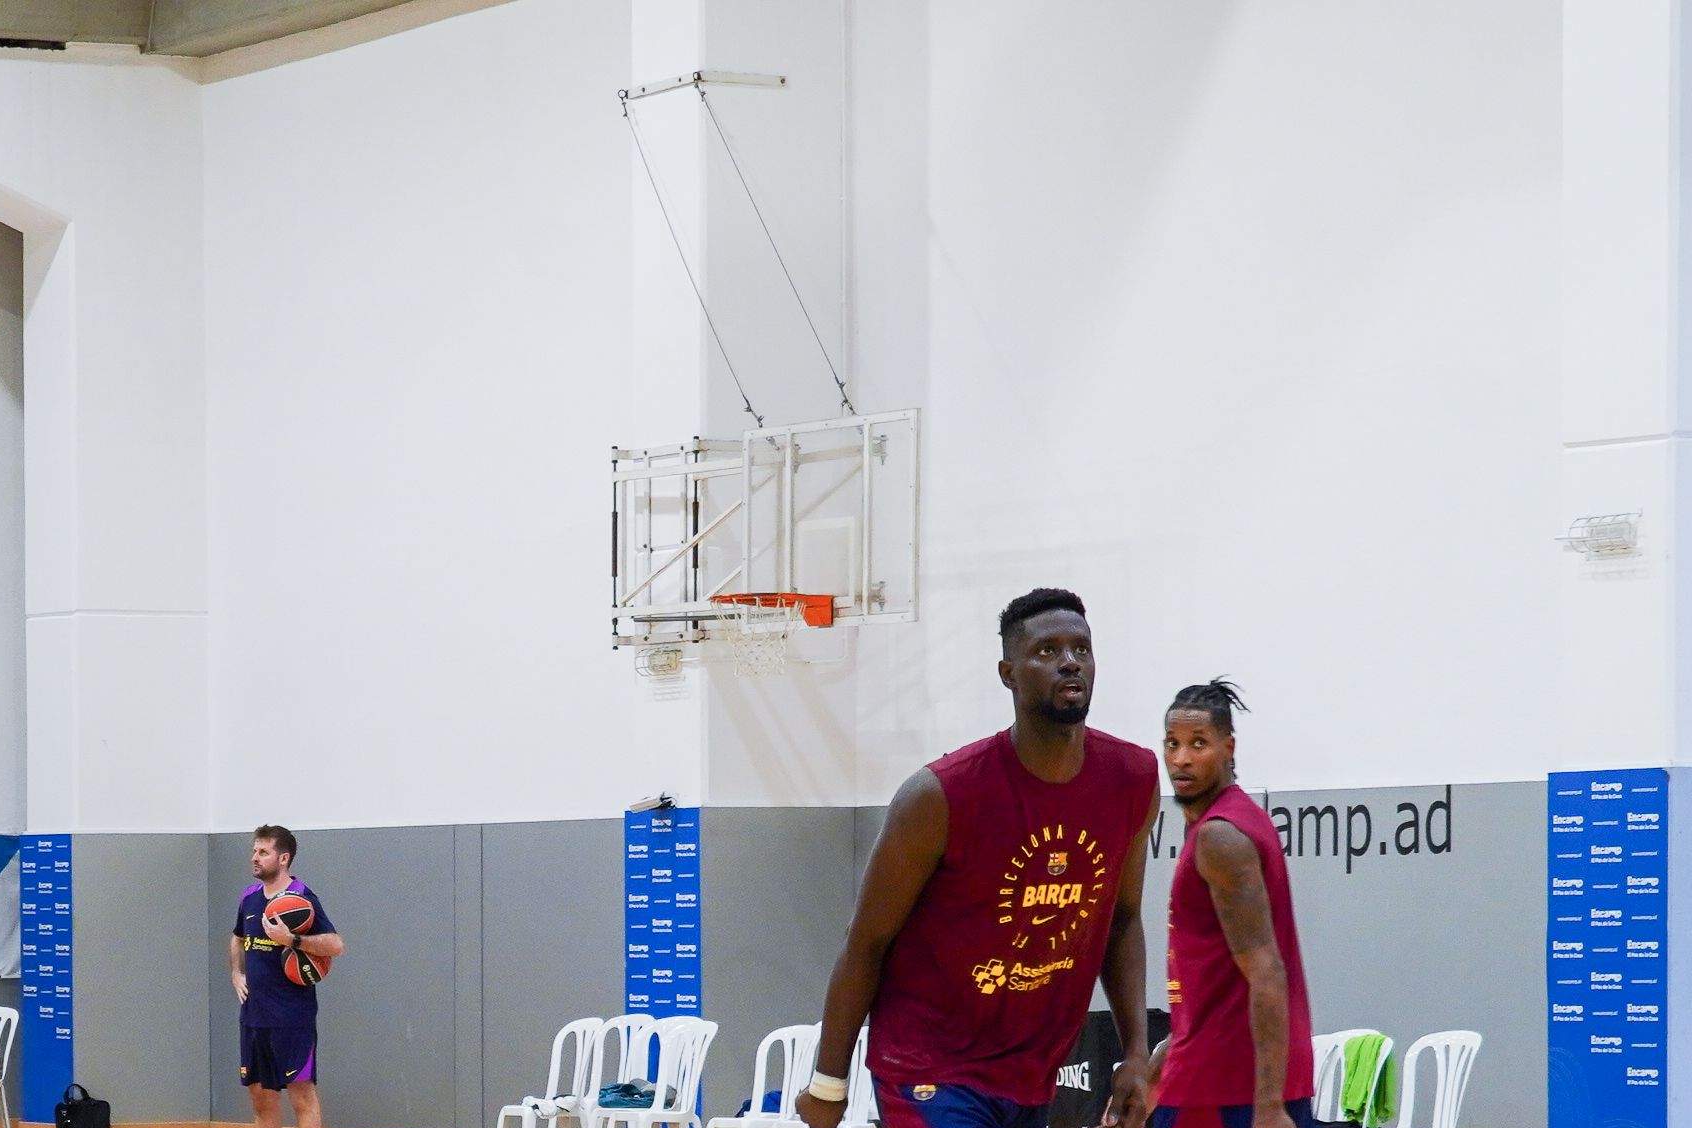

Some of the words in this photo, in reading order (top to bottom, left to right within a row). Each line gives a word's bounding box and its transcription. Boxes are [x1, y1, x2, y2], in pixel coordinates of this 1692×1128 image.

[998, 824, 1063, 924] BARCELONA
[1022, 883, 1083, 908] BARÇA
[1055, 1060, 1092, 1092] DING
